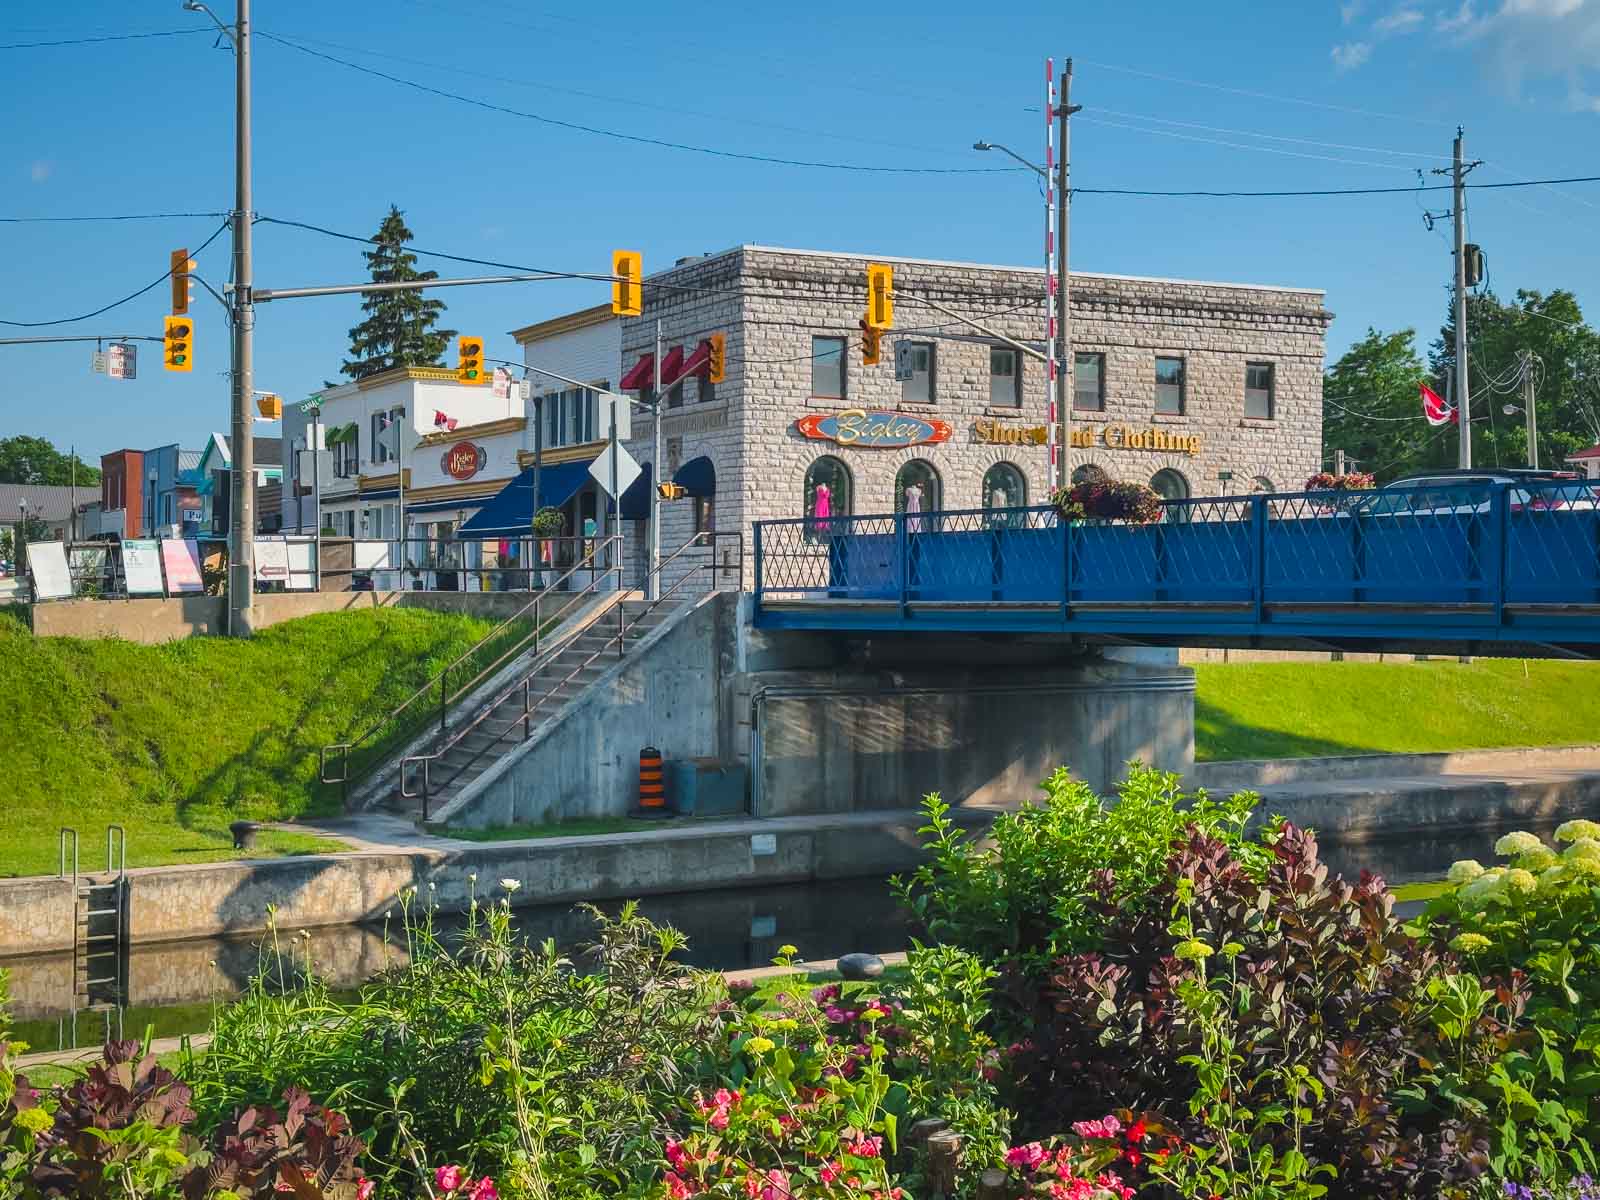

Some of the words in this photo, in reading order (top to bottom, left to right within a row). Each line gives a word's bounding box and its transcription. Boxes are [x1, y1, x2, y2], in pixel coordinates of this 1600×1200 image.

[836, 408, 922, 448] Bigley
[975, 415, 1040, 444] Shoe
[1070, 424, 1096, 448] nd
[1104, 423, 1202, 456] Clothing
